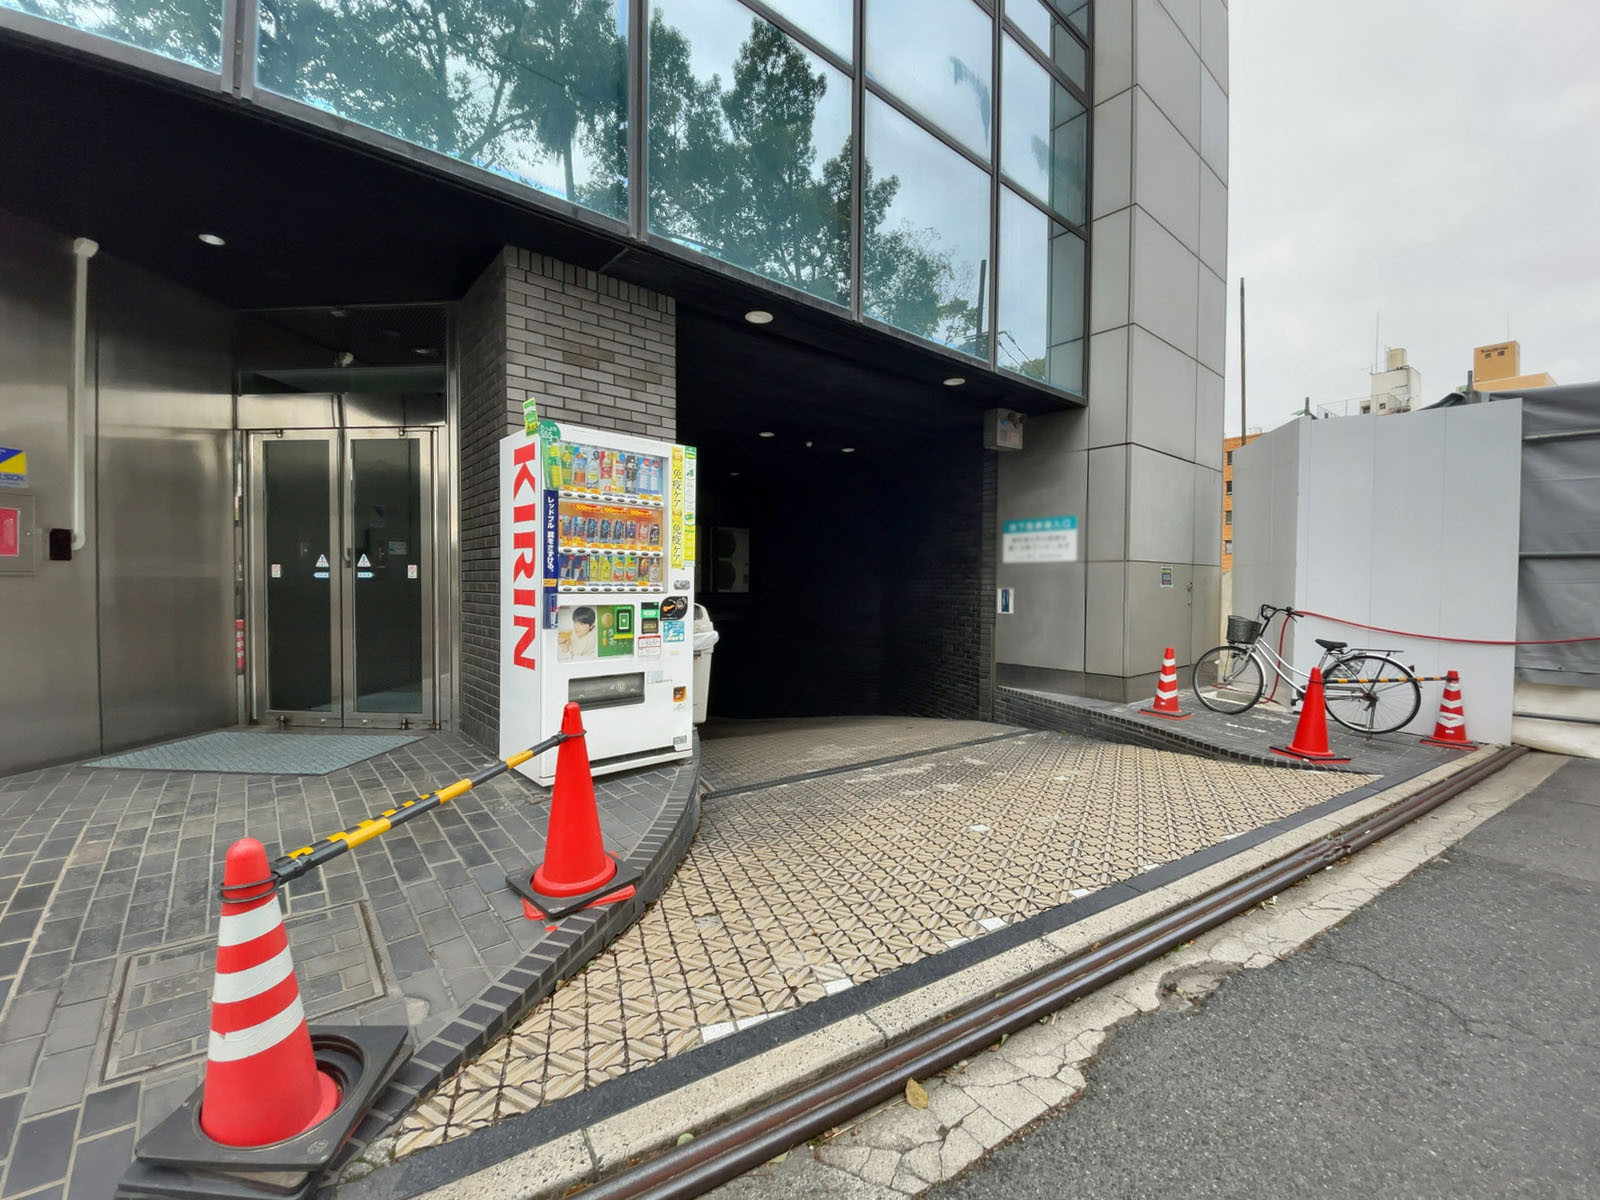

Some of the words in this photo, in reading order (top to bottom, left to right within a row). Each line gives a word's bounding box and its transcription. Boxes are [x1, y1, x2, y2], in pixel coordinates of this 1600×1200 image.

[672, 469, 682, 508] 免疫ケア
[514, 443, 536, 670] KIRIN
[671, 524, 682, 562] 免疫ケア
